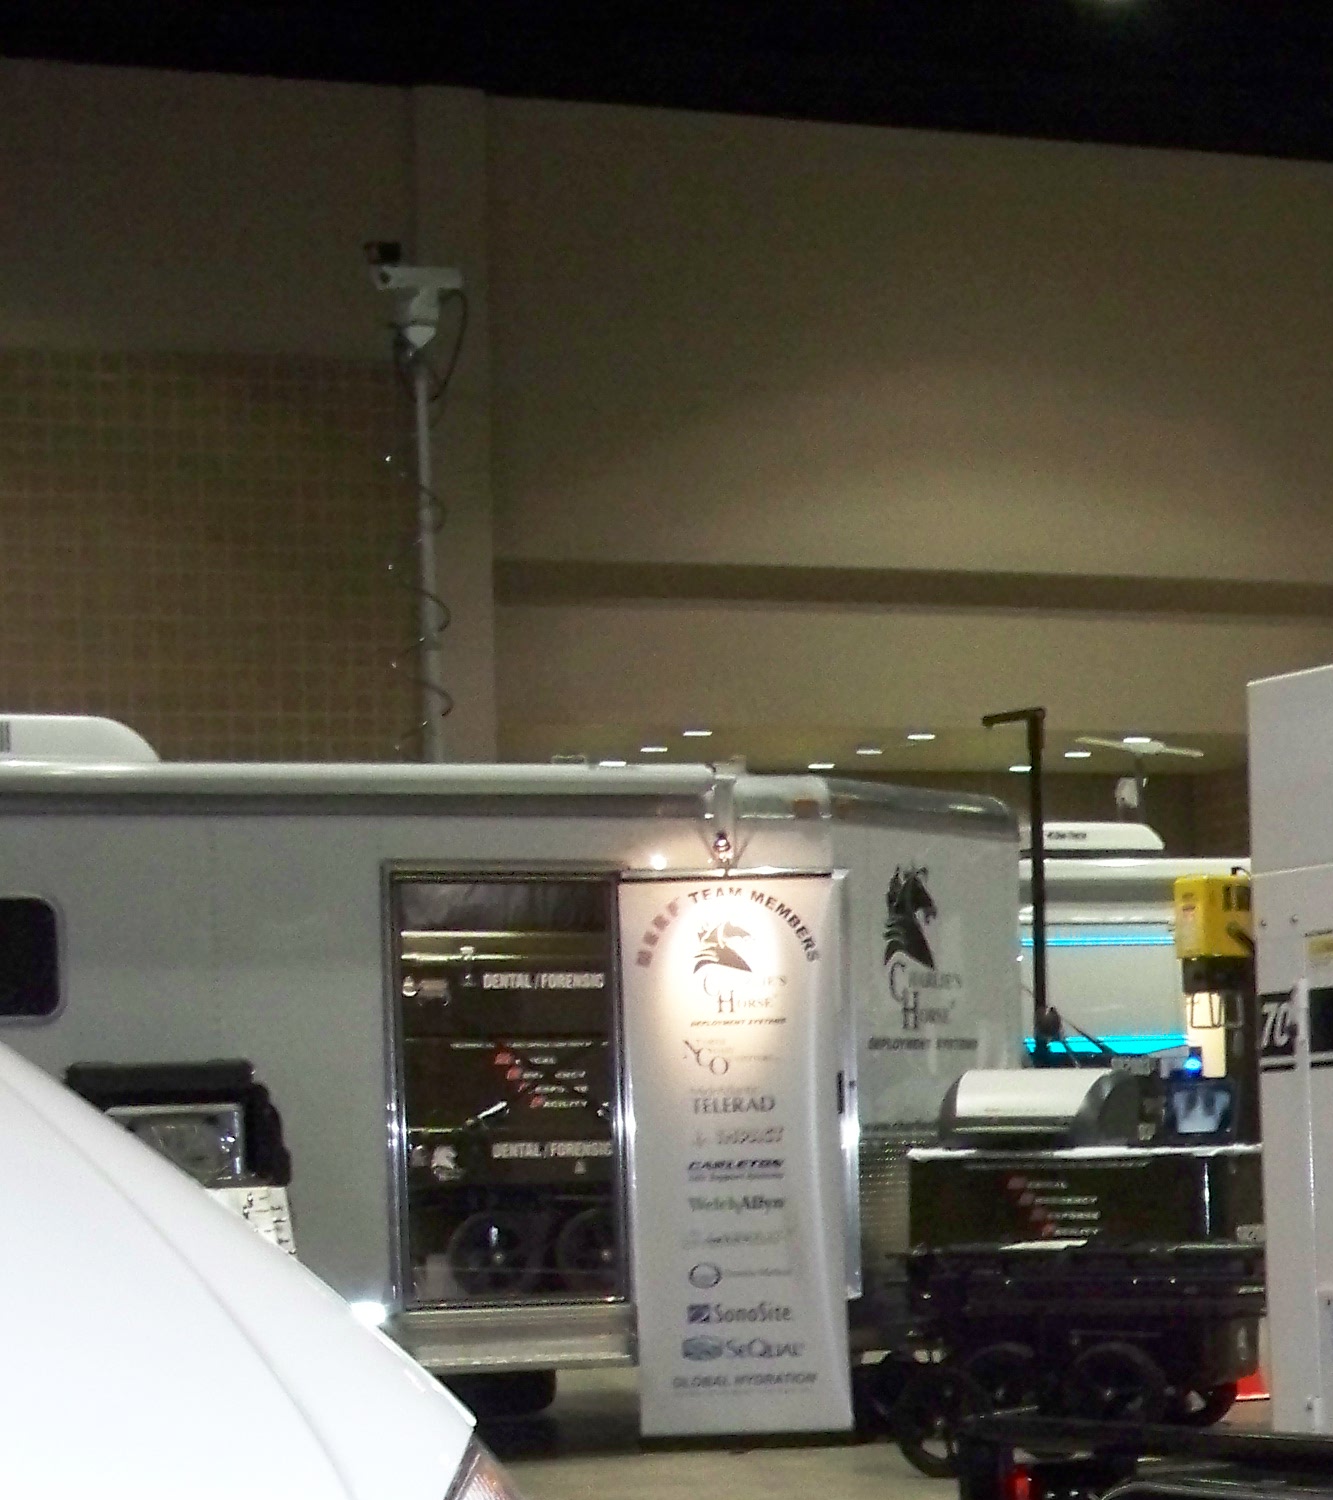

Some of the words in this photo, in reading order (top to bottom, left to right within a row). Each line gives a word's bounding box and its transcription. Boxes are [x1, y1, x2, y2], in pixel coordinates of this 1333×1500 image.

[687, 886, 743, 904] TEAM
[749, 889, 820, 964] MEMBERS
[693, 1095, 777, 1115] TELERAD
[714, 1302, 792, 1324] SonoSite
